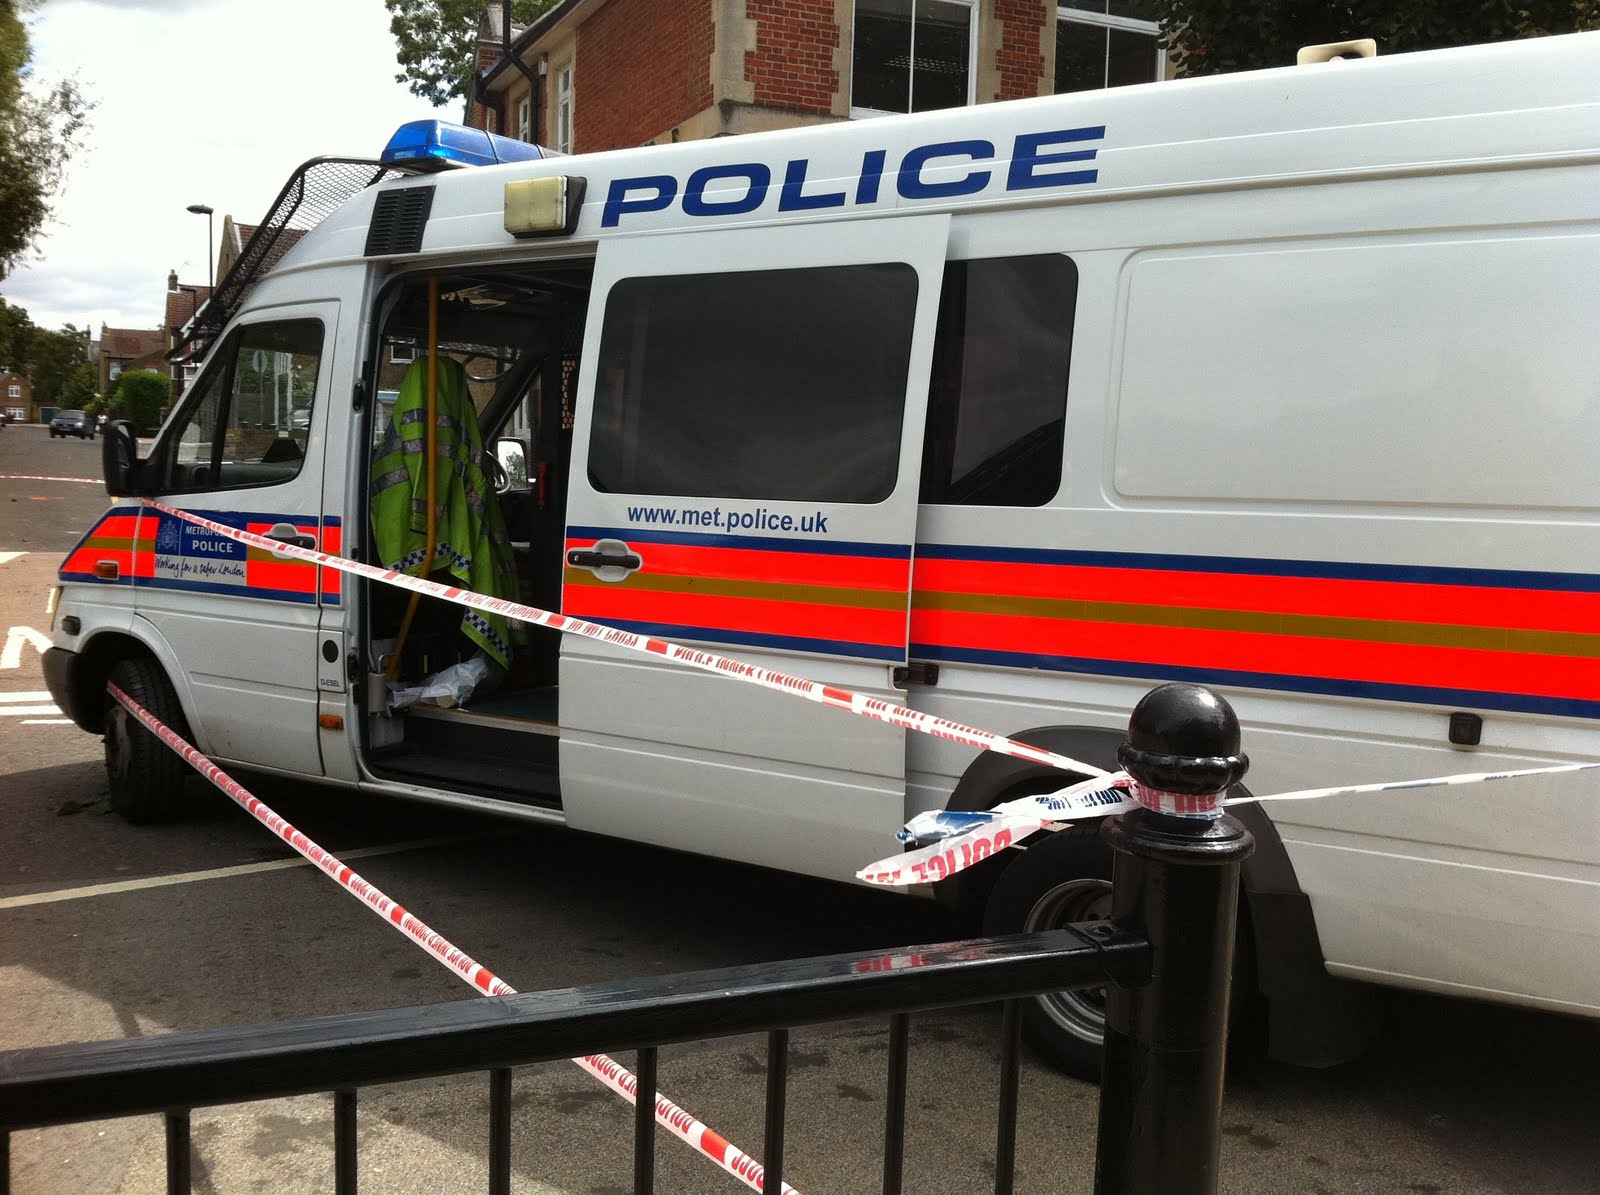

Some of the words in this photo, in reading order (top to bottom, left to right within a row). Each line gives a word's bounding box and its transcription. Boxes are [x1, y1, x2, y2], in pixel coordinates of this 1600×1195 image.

[600, 125, 1106, 228] POLICE
[627, 506, 829, 533] www.met.police.uk
[192, 540, 233, 553] POLICE
[155, 554, 179, 578] Working
[180, 558, 192, 578] for
[193, 564, 198, 573] a
[199, 561, 217, 577] safer
[217, 562, 246, 578] London
[320, 678, 341, 688] DIESEL
